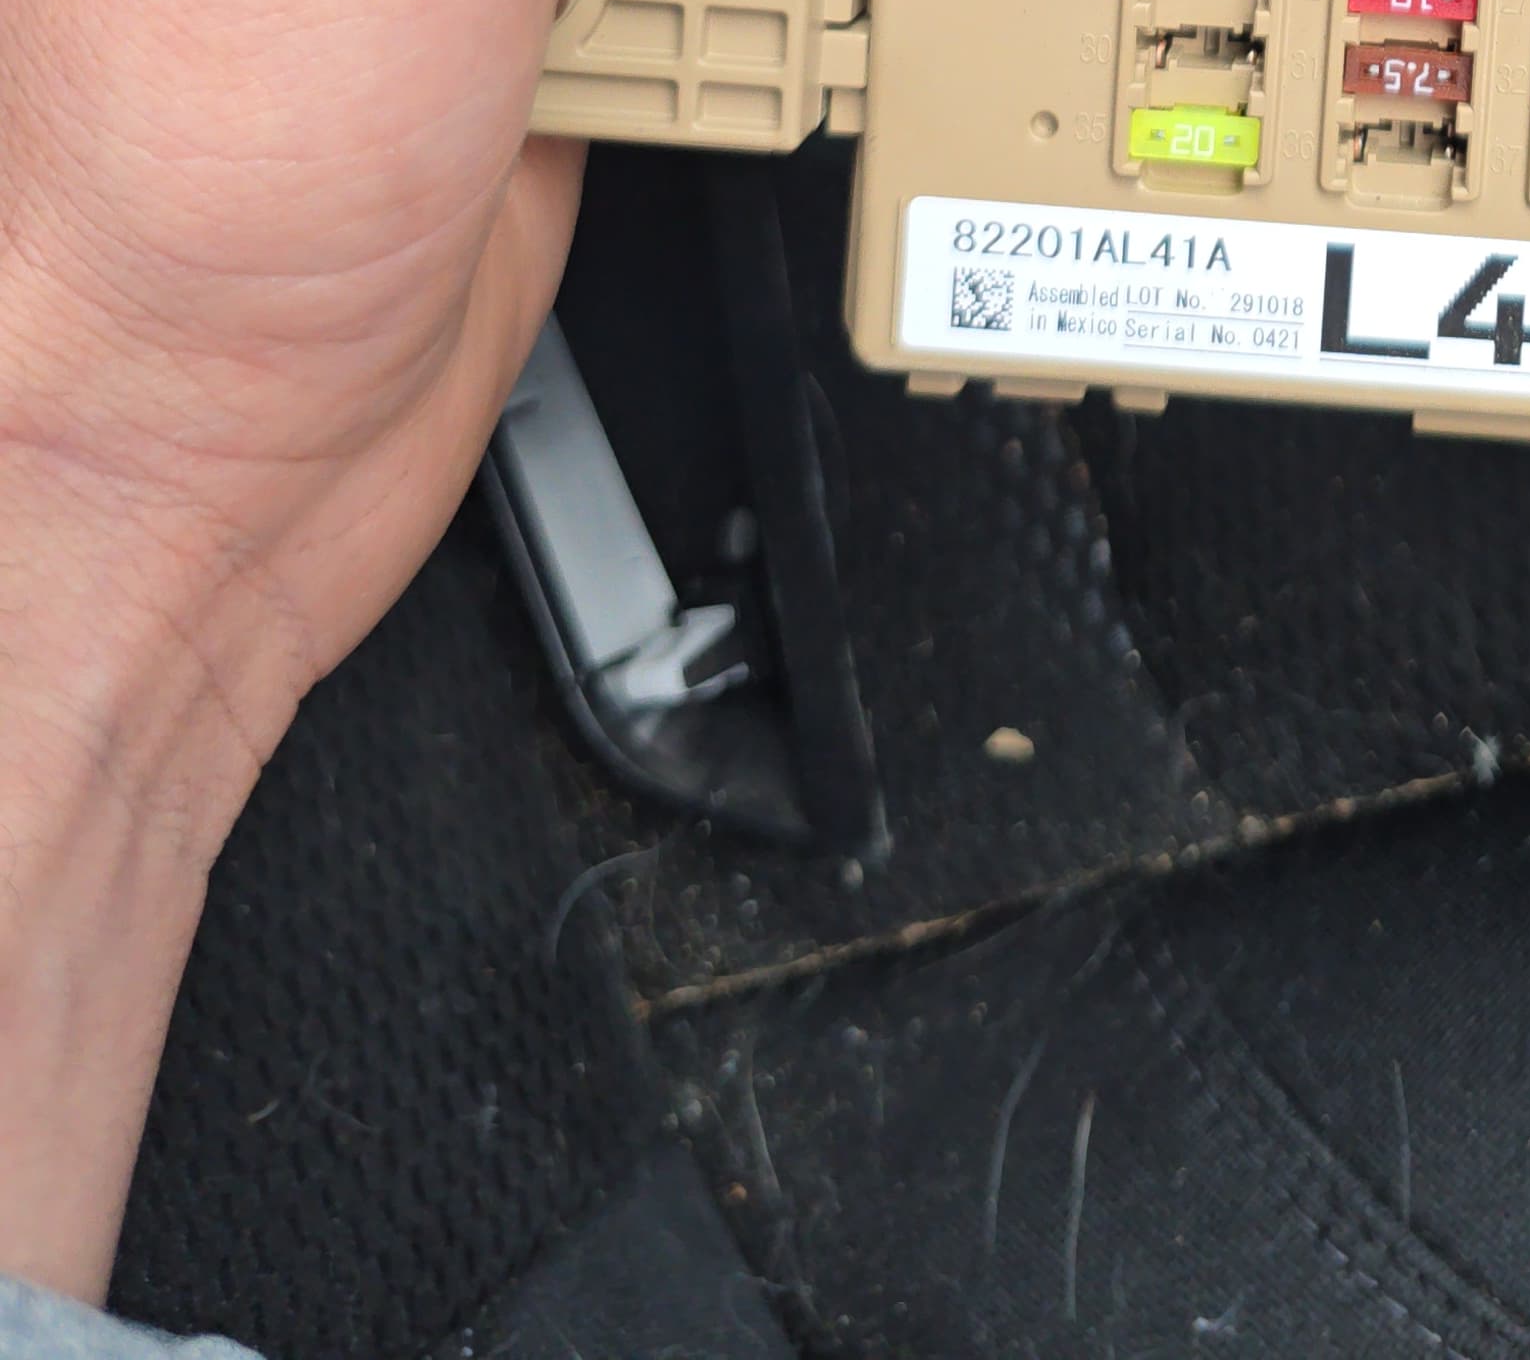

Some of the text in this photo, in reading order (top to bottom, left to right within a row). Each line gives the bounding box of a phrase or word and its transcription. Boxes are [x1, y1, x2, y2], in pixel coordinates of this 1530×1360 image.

[1083, 34, 1112, 62] 30
[1383, 61, 1434, 93] 7.5
[1497, 66, 1528, 94] 32
[1171, 124, 1213, 156] 20
[1285, 130, 1314, 158] 36
[953, 218, 1232, 272] 82201AL41A
[1028, 282, 1120, 309] Assembled
[1125, 284, 1305, 317] LOT No. 291018
[1028, 311, 1119, 337] in Mexico
[1123, 317, 1301, 351] Serial No. 0421
